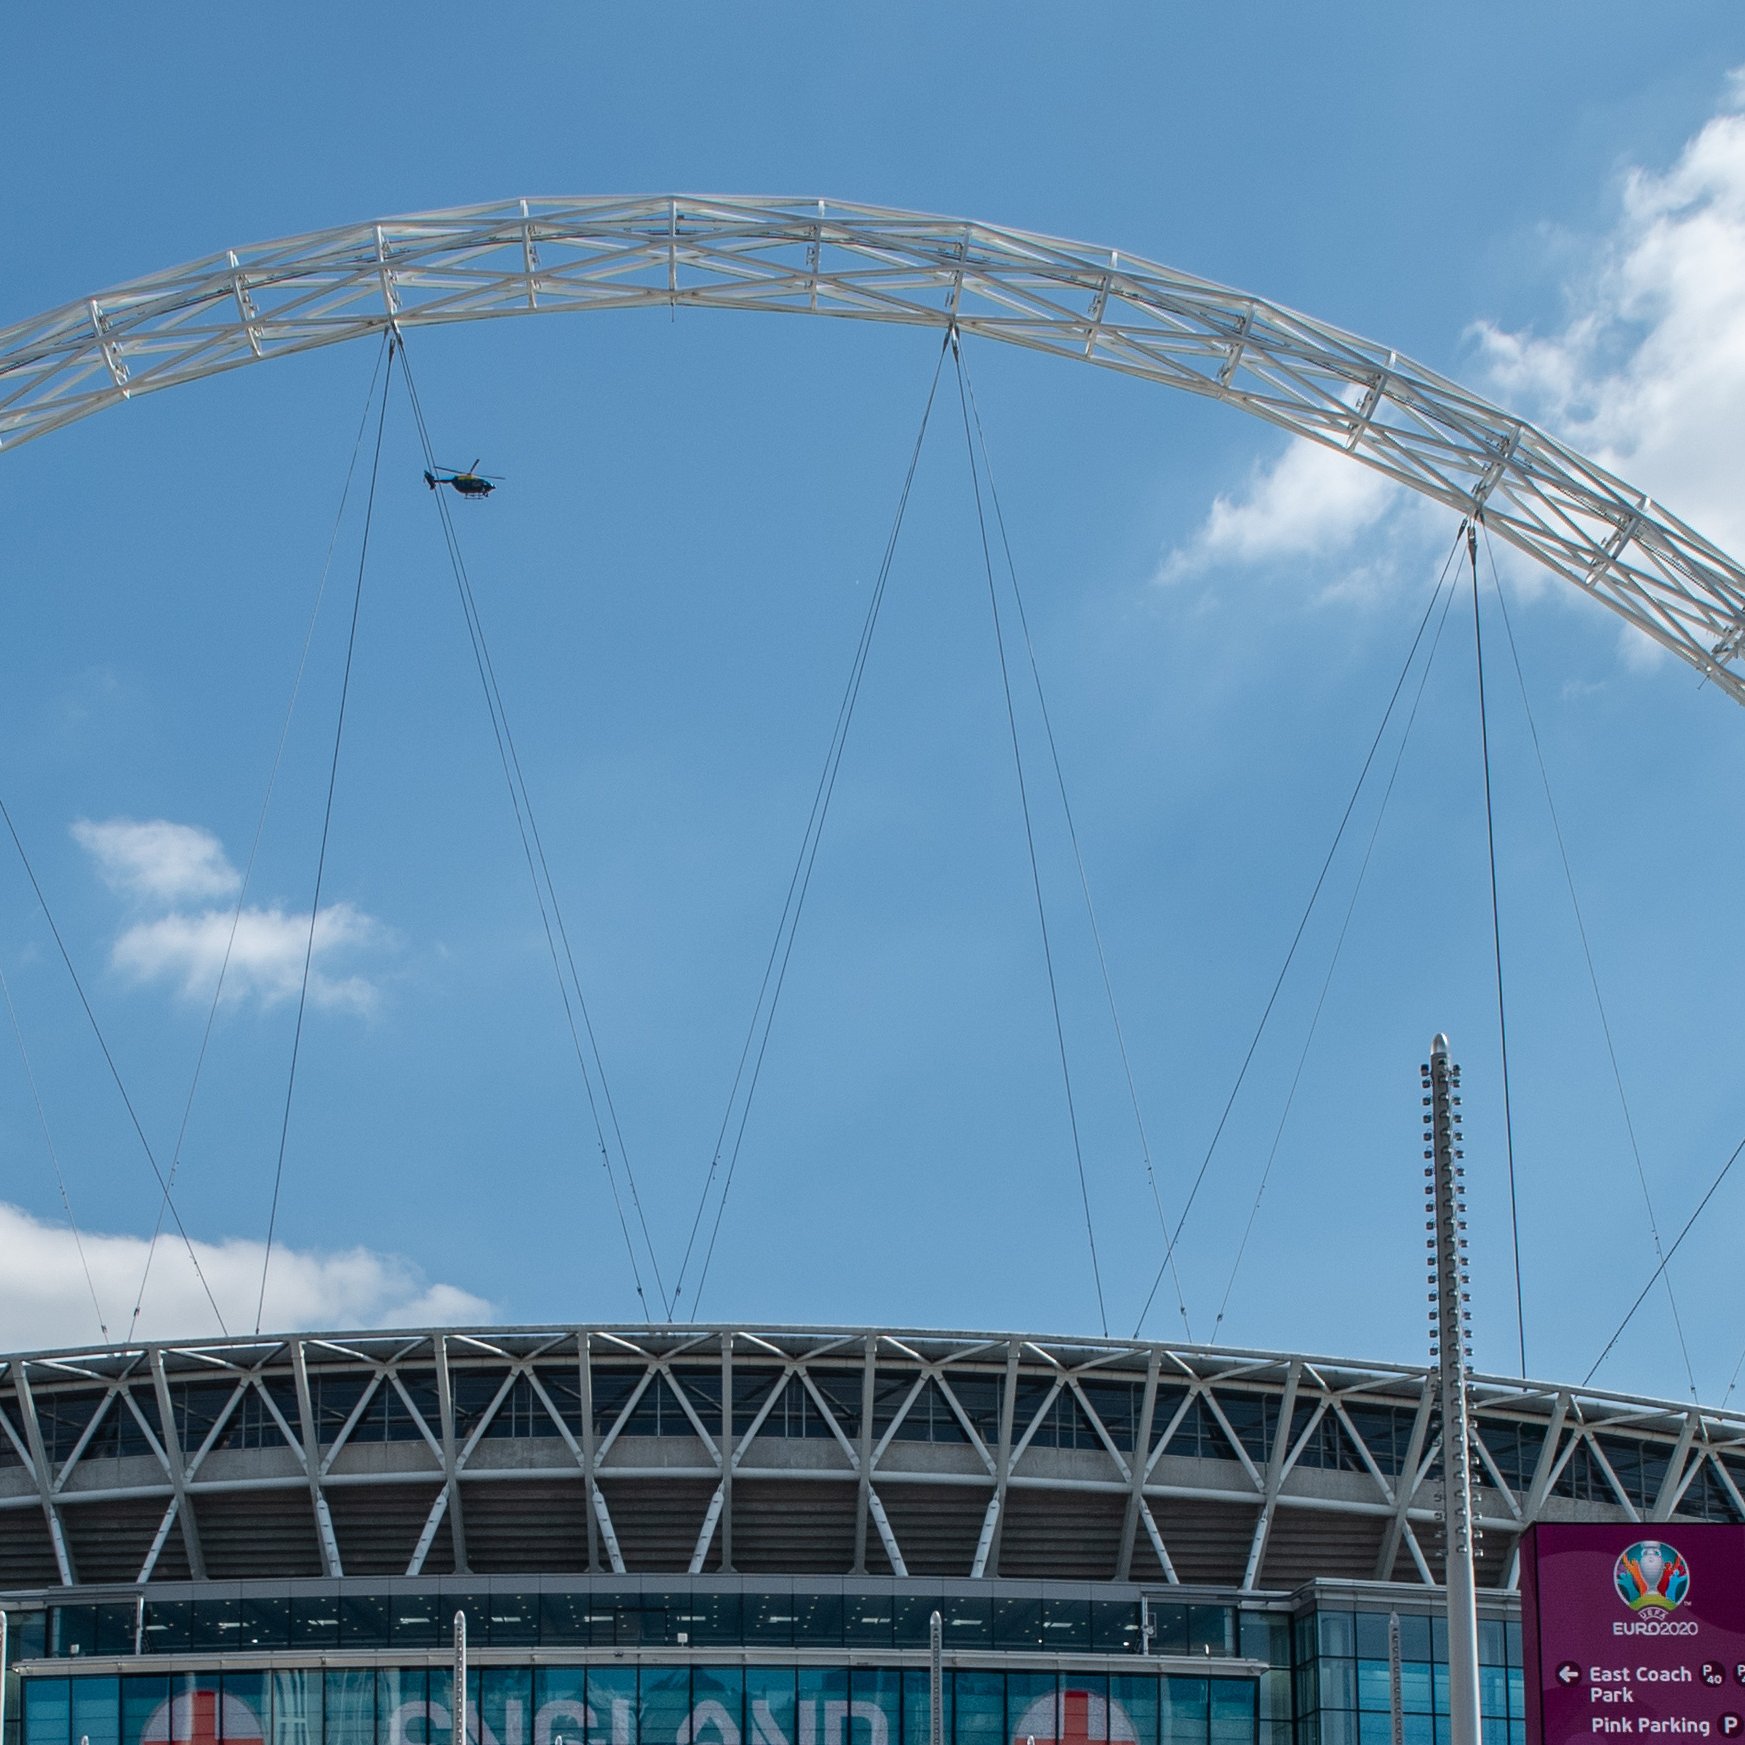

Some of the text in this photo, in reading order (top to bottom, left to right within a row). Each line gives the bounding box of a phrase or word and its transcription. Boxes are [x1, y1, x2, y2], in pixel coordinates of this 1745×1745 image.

[1638, 1608, 1667, 1621] UEFA
[1613, 1622, 1698, 1635] EURO2020
[1590, 1667, 1630, 1681] East
[1637, 1666, 1691, 1681] Coach
[1591, 1687, 1633, 1702] Park
[1593, 1717, 1737, 1736] Pink Parking P
